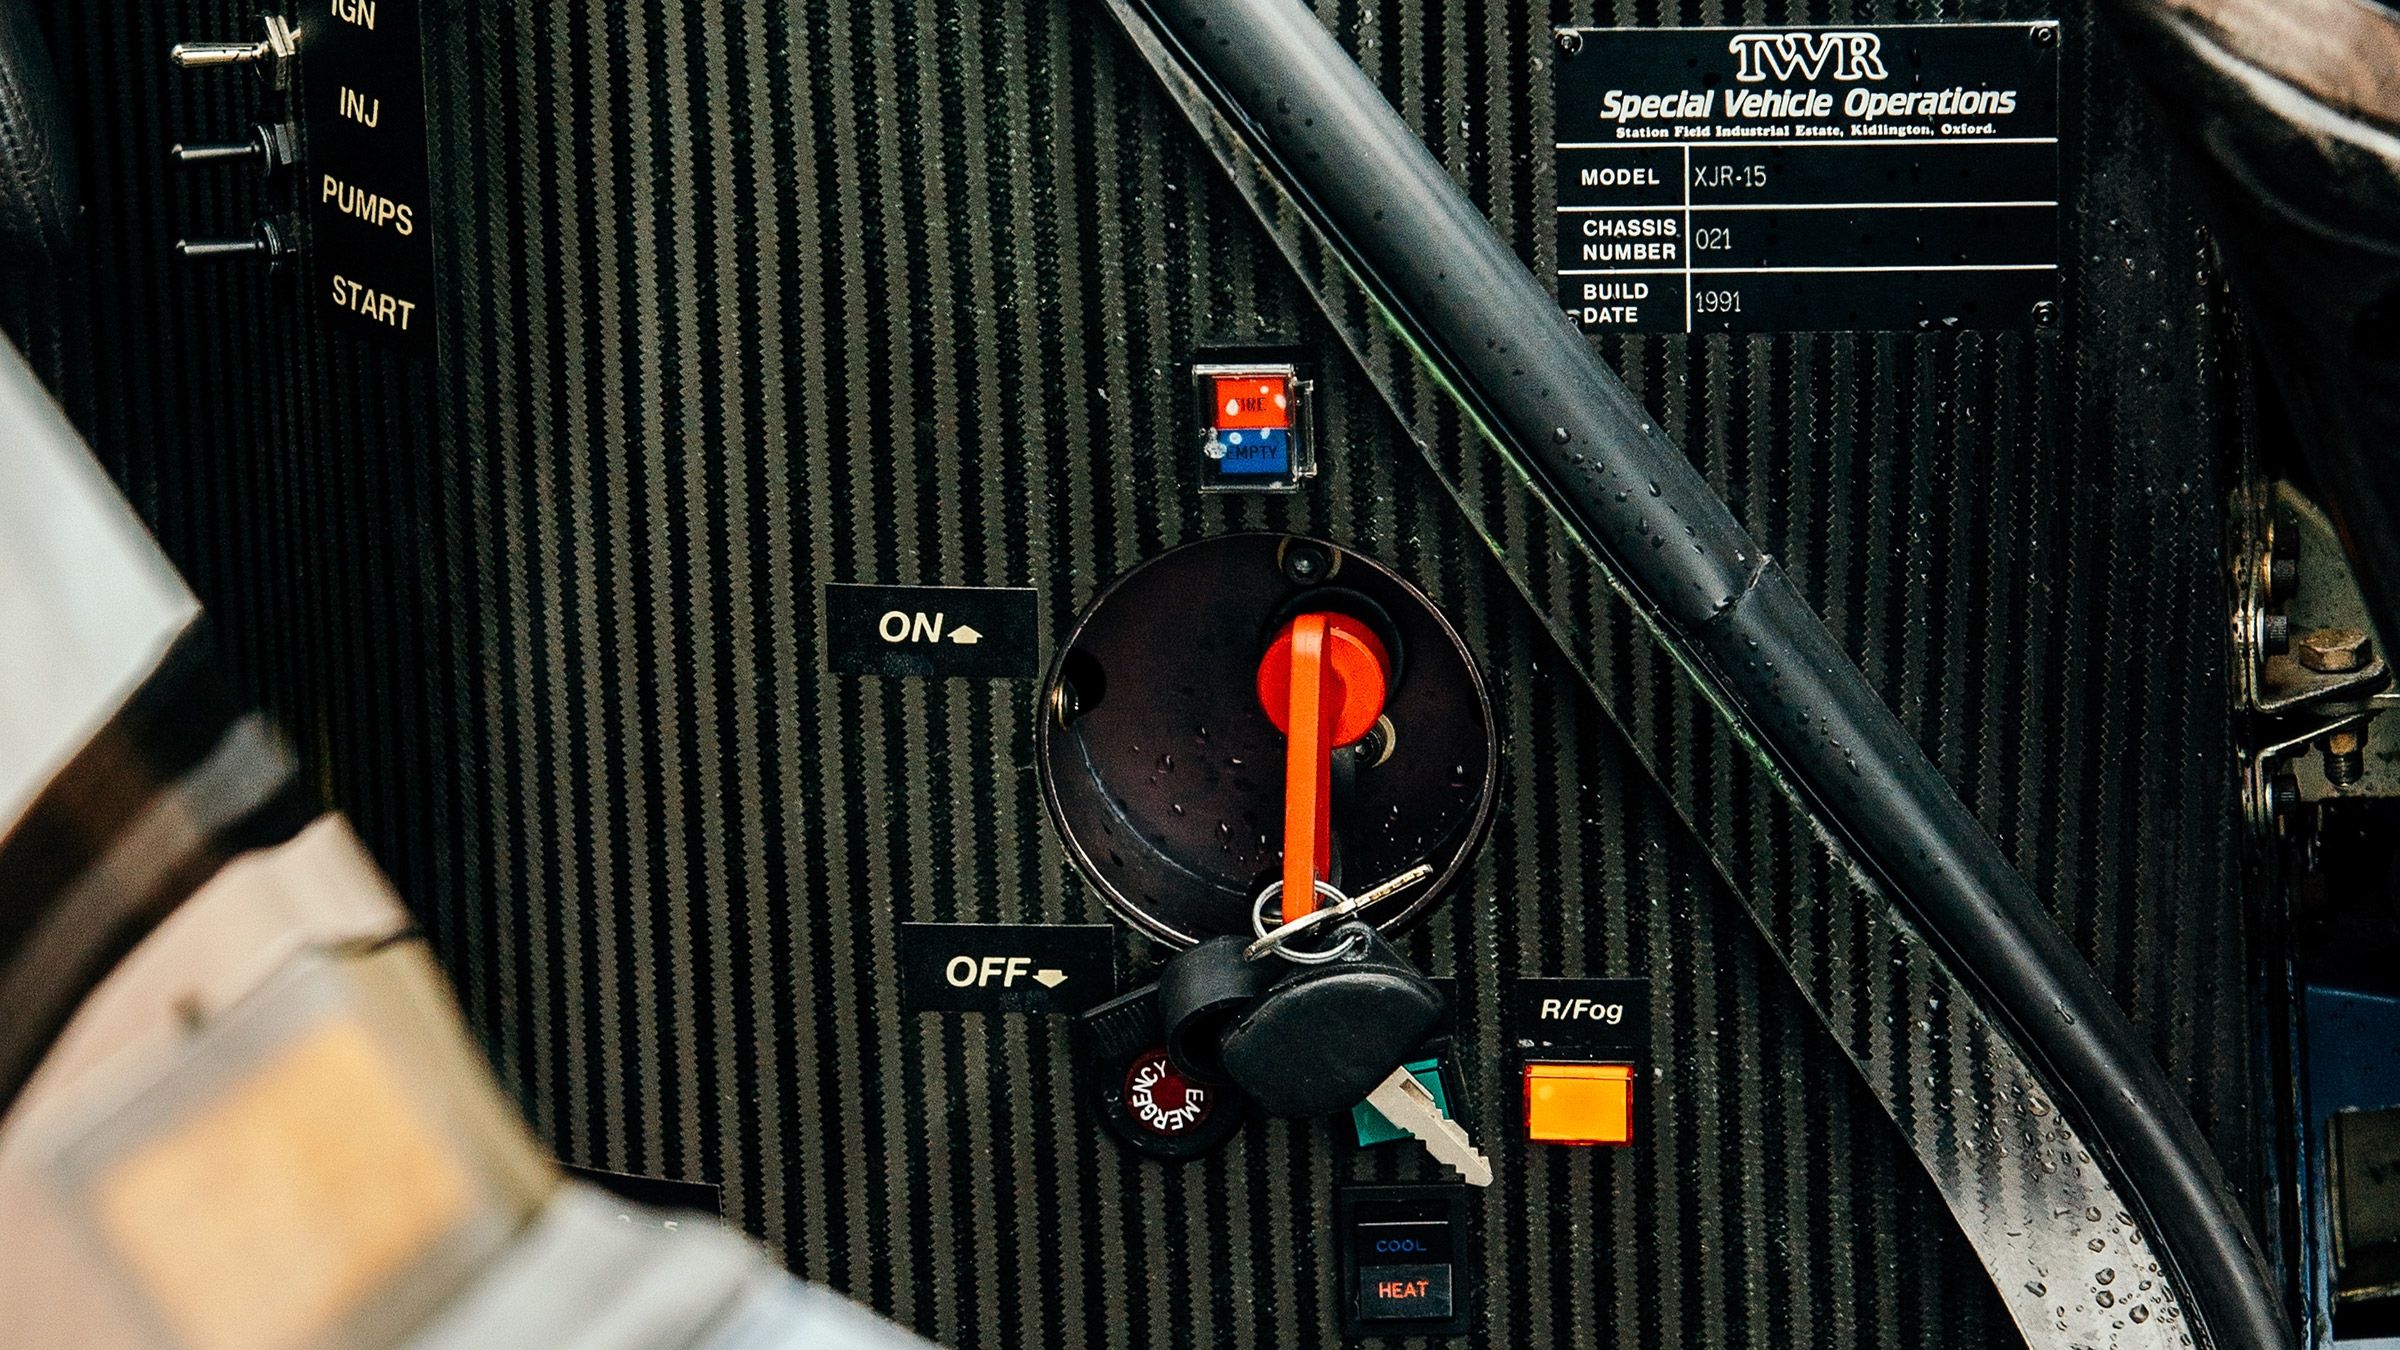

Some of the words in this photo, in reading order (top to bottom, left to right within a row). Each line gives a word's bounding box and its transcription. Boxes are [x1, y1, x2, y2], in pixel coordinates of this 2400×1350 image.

[1729, 33, 1888, 82] TWR
[340, 86, 379, 128] INJ
[1600, 90, 1715, 124] Special
[1725, 88, 1833, 118] Vehicle
[1845, 87, 2017, 121] Operations
[1616, 127, 1669, 138] Station
[1674, 126, 1711, 138] Field
[1716, 125, 1790, 137] Industrial
[1795, 125, 1845, 137] Estate,
[1850, 124, 1935, 137] Kidlington,
[1941, 123, 1997, 135] Oxford.
[1581, 168, 1660, 186] MODEL
[1694, 166, 1767, 187] XJR-15
[322, 174, 413, 236] PUMPS
[1583, 218, 1677, 238] CHASSIS
[1696, 228, 1732, 250] 021
[1583, 243, 1676, 261] NUMBER
[332, 274, 416, 331] START
[1583, 283, 1649, 301] BUILD
[1696, 291, 1742, 313] 1991
[1583, 306, 1638, 324] DATE
[1226, 445, 1278, 460] EMPTY
[879, 611, 943, 643] ON
[946, 955, 1031, 988] OFF
[1541, 998, 1624, 1025] R/Fog
[1132, 1060, 1204, 1131] EMERGENCY
[1376, 1239, 1427, 1253] COOL
[1378, 1280, 1429, 1299] HEAT
